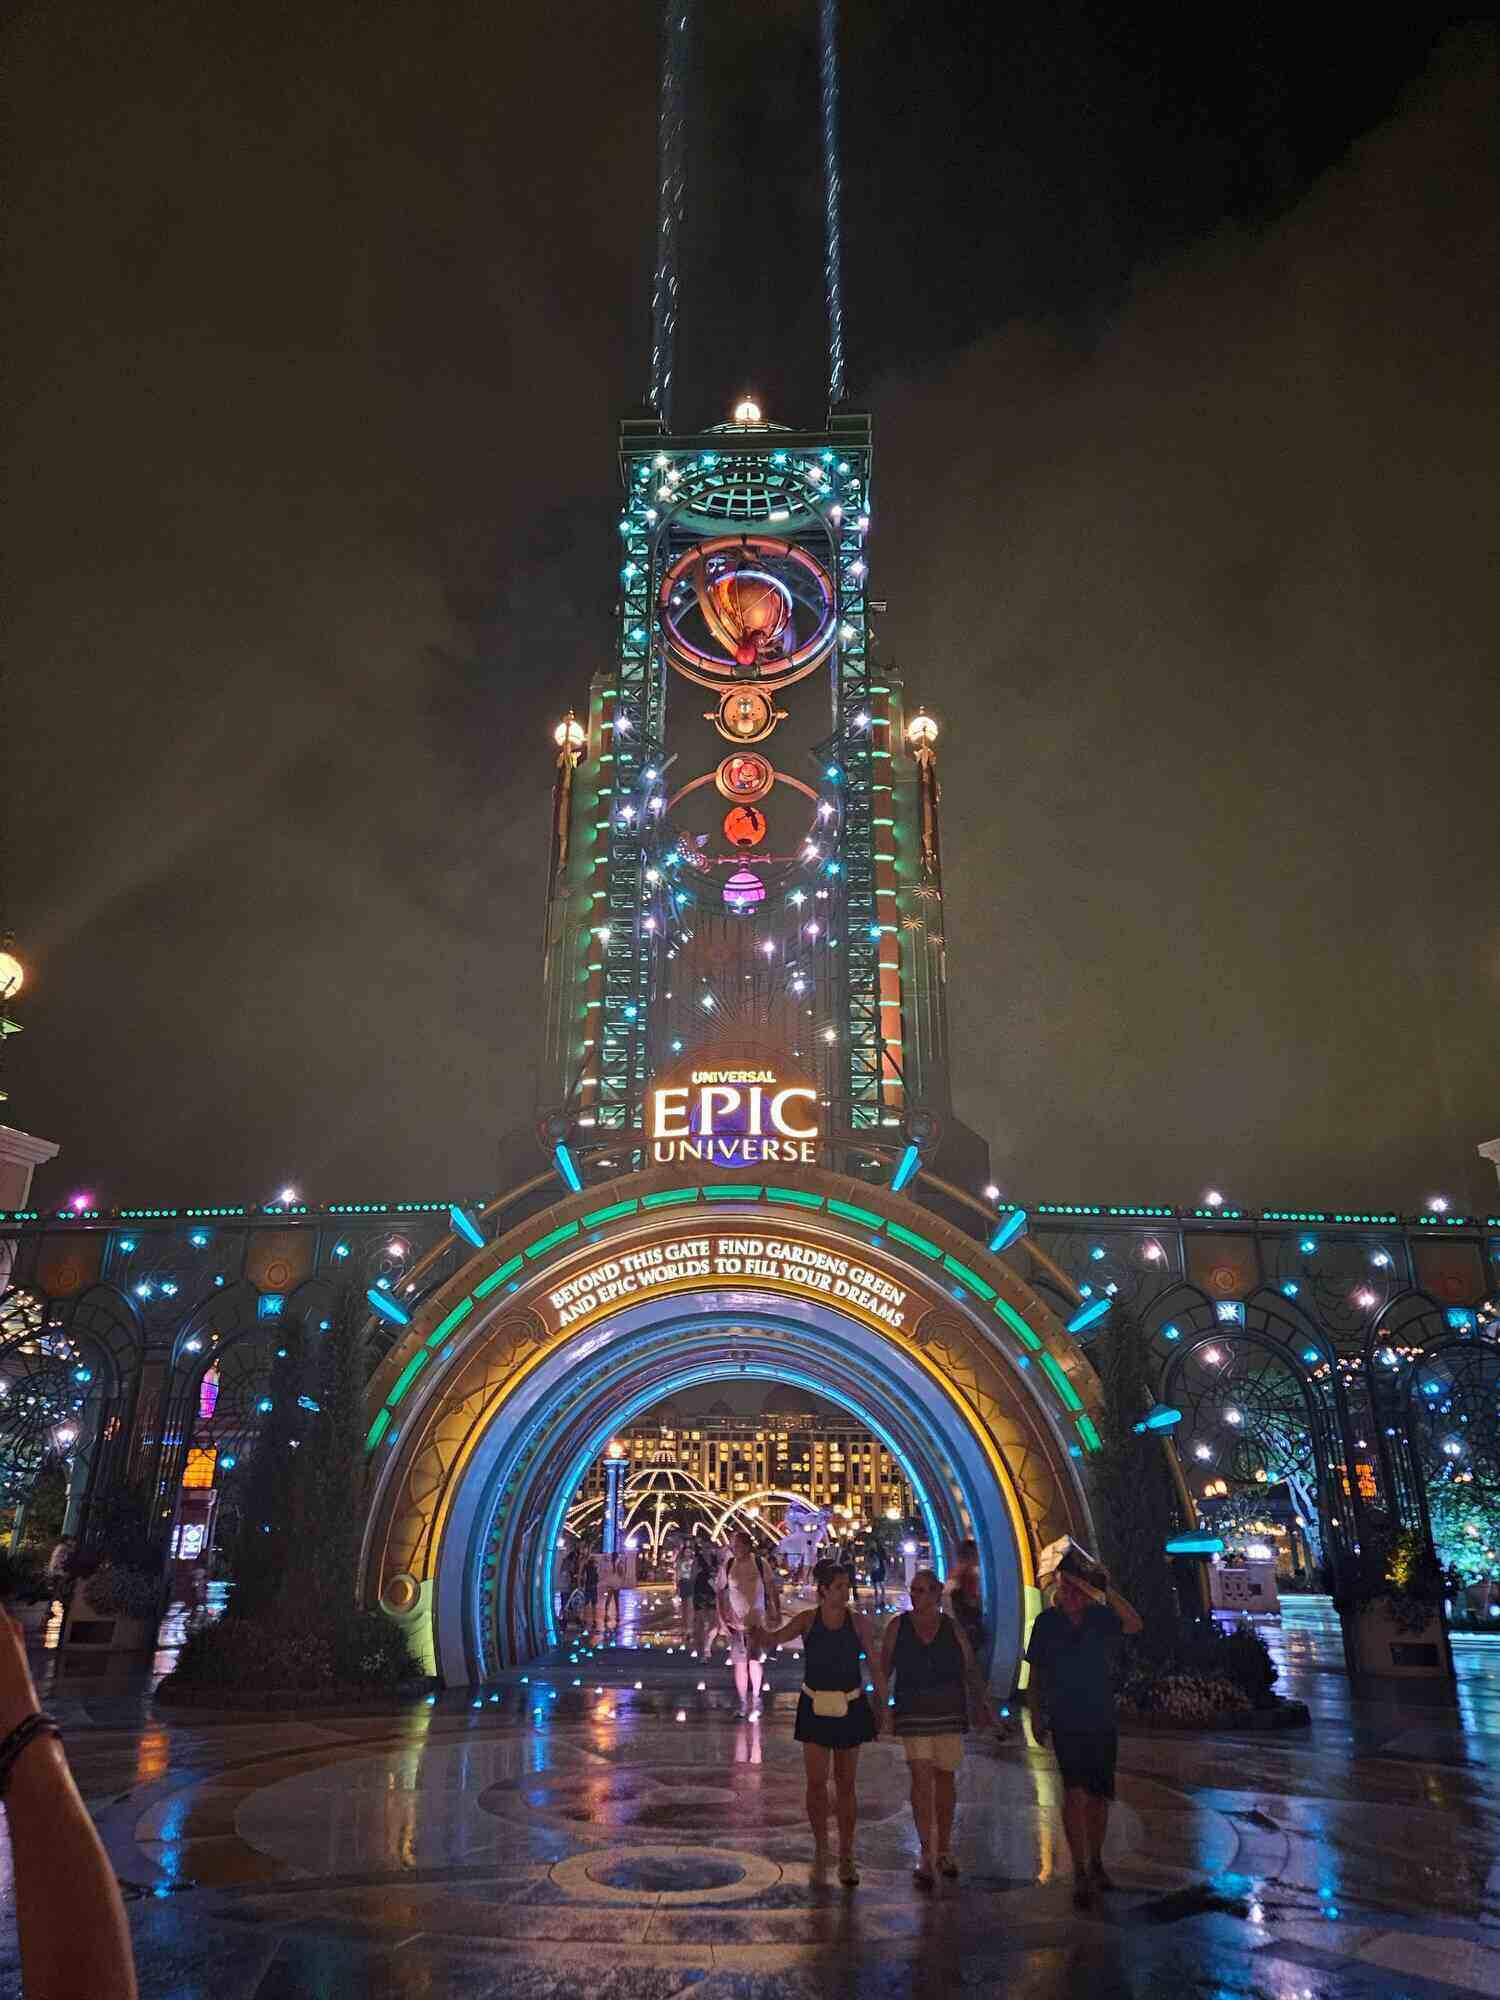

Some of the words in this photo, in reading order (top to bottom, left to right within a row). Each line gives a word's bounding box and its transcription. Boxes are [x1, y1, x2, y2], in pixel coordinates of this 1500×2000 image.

[692, 1071, 776, 1083] UNIVERSAL
[654, 1086, 818, 1138] EPIC
[654, 1139, 817, 1163] UNIVERSE
[551, 1264, 620, 1309] BEYOND
[620, 1247, 663, 1273] THIS
[665, 1240, 710, 1260] GATE
[718, 1240, 763, 1255] FIND
[765, 1242, 848, 1274] GARDENS
[849, 1267, 906, 1306] GREEN
[559, 1294, 597, 1327] AND
[597, 1276, 638, 1303] EPIC
[637, 1259, 710, 1286] WORLDS
[714, 1258, 741, 1273] TO
[744, 1259, 780, 1277] FILL
[782, 1263, 833, 1292] YOUR
[833, 1279, 905, 1327] DREAMS
